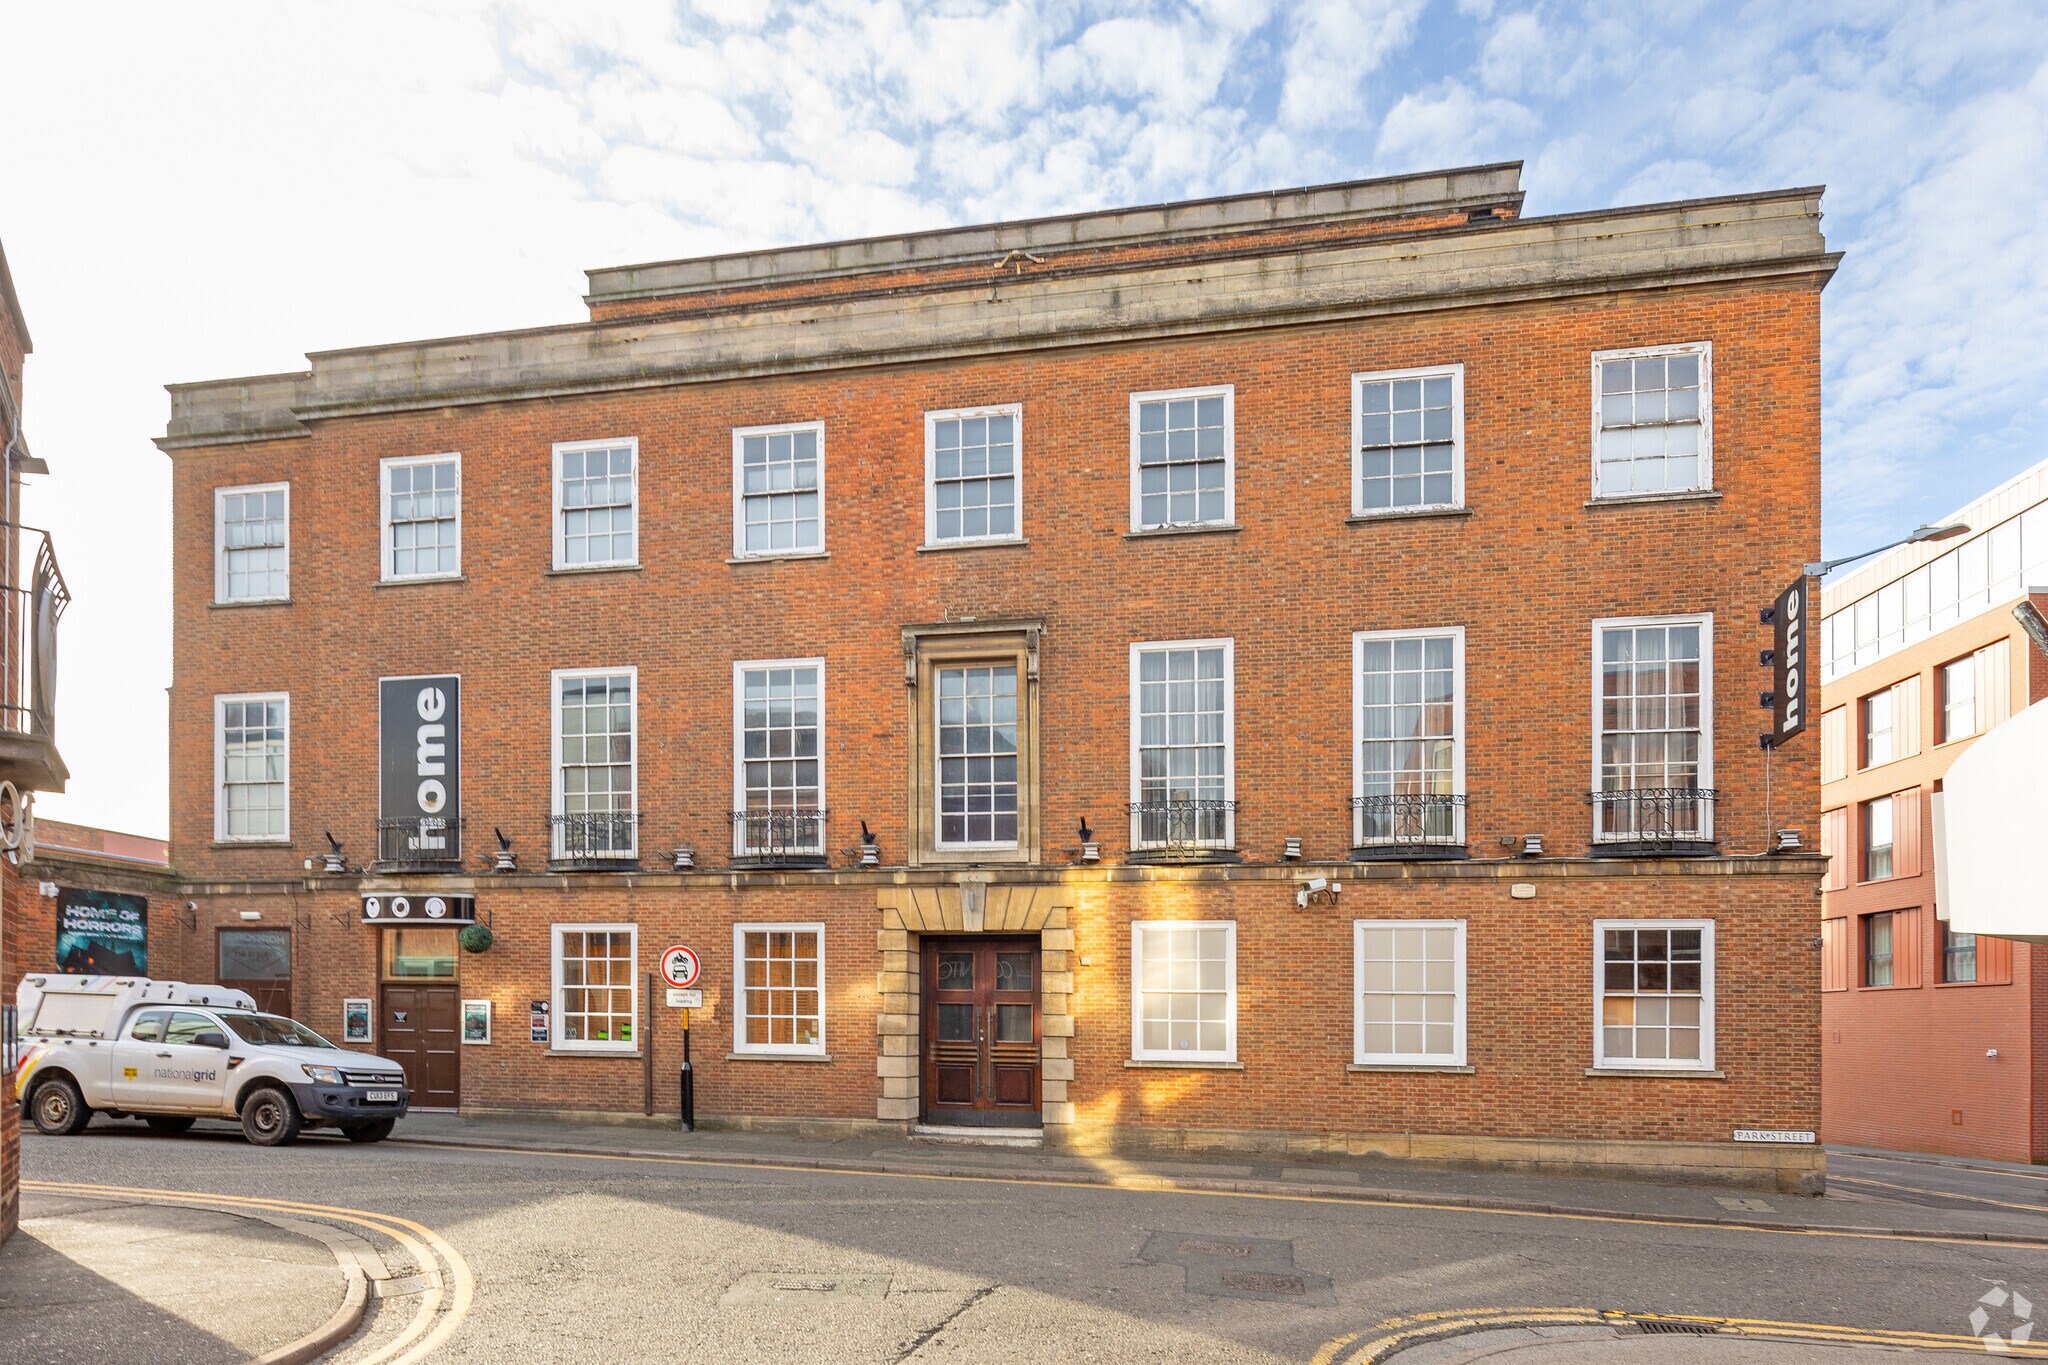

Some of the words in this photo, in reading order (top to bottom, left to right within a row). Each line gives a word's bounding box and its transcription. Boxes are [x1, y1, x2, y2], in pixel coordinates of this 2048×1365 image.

[1783, 589, 1799, 733] home
[408, 686, 446, 850] home
[65, 905, 117, 919] HOME
[119, 910, 140, 921] OF
[63, 918, 142, 935] HORRORS
[154, 1067, 216, 1082] nationalgrid
[1737, 1131, 1766, 1140] PARK
[1771, 1132, 1812, 1141] STREET
